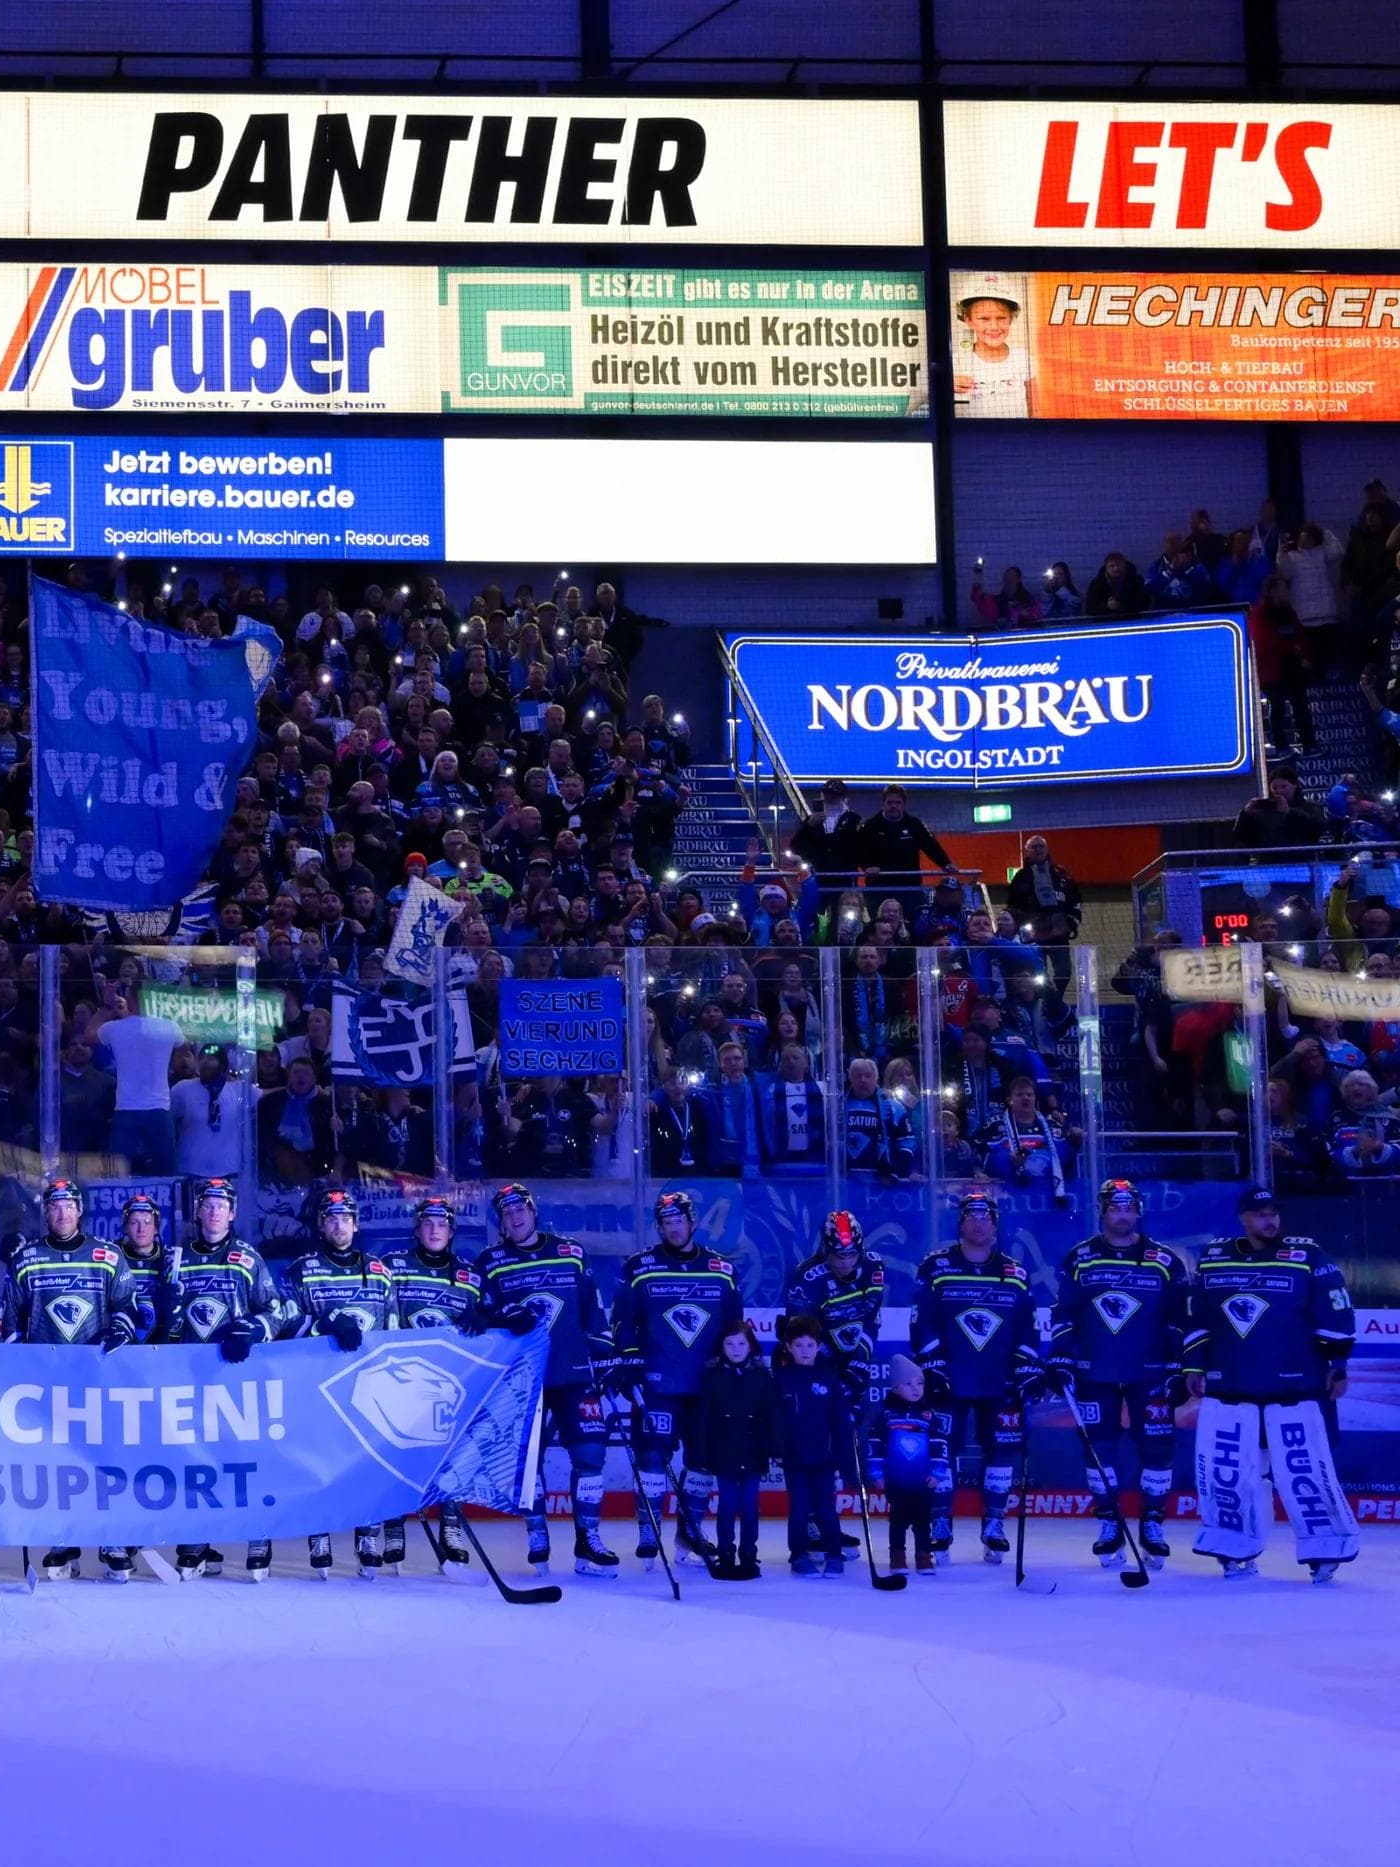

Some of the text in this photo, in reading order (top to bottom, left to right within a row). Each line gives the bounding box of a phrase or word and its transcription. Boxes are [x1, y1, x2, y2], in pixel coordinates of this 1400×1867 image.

[135, 111, 707, 227] PANTHER
[1034, 120, 1333, 231] LET'S
[78, 267, 220, 304] MÖBEL
[589, 274, 919, 302] EISZEIT gibt es nur in der Arena
[1049, 284, 1400, 329] HECHINGER
[590, 313, 919, 348] Heizöl und Kraftstoffe
[1230, 334, 1341, 350] Baukompetenz
[1345, 336, 1371, 348] seit
[68, 290, 385, 410] gruber
[591, 354, 921, 388] direkt vom Hersteller
[1164, 361, 1304, 375] HOCH- & TIEFBAU
[467, 373, 566, 393] GUNVOR
[1094, 379, 1376, 395] ENTSORGUNG & CONTAINERDIENST
[132, 398, 386, 410] Siemensstr. 7 Gaimersheim
[723, 401, 741, 411] Tel.
[1123, 397, 1291, 412] SCHLÜSSELFERTIGES
[104, 451, 333, 476] Jetzt bewerben!
[105, 484, 355, 510] karriere.bauer.de
[104, 528, 429, 547] Spezialtiefbau Maschinen Resources
[896, 652, 1061, 680] Privatbrauerei
[40, 670, 248, 744] Young,
[808, 675, 1152, 743] NORDBRÄU
[896, 744, 1064, 769] INGOLSTADT
[42, 749, 228, 810] Wild &
[39, 827, 165, 884] Free
[518, 990, 604, 1013] SZENE
[503, 1019, 617, 1042] VIERUND
[506, 1049, 618, 1071] SECHZIG
[1214, 1423, 1243, 1533] BÜCHL
[1280, 1423, 1332, 1536] BÜCHL
[1004, 1494, 1095, 1514] PENNY
